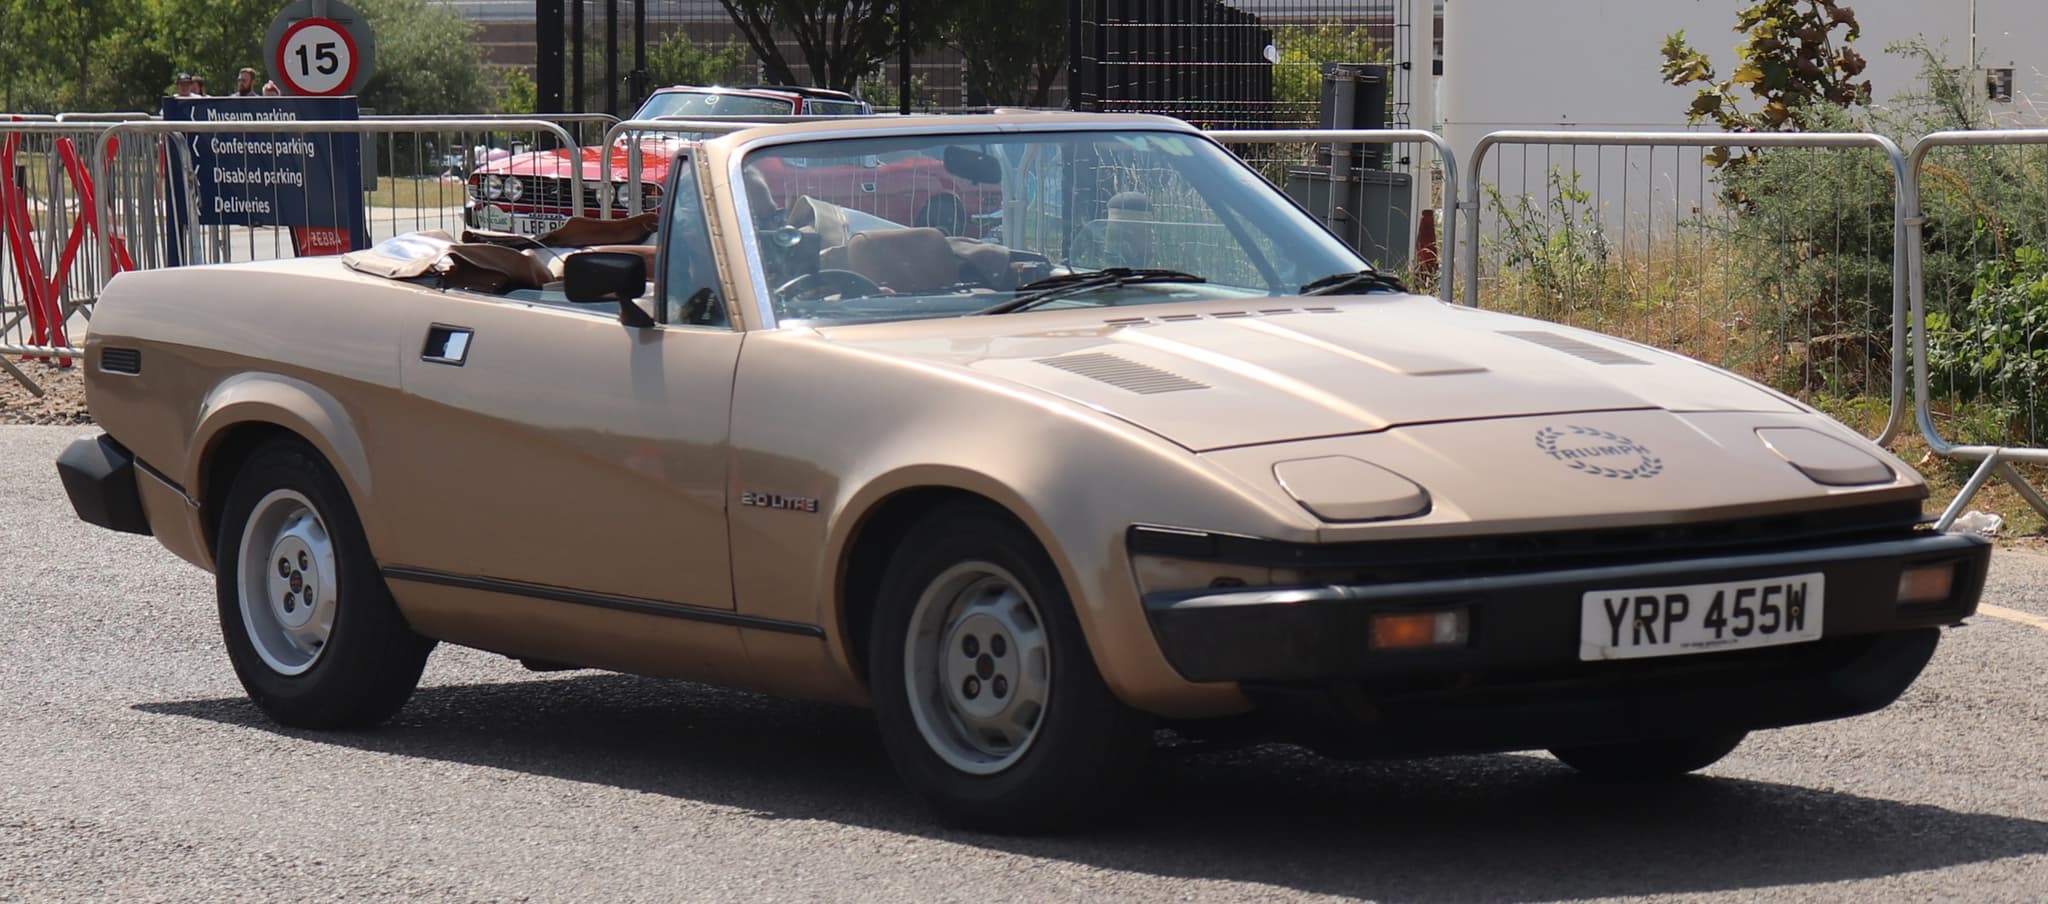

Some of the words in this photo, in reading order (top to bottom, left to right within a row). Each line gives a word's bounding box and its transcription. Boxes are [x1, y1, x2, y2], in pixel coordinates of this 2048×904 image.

[295, 42, 339, 76] 15
[207, 108, 253, 121] Museum
[211, 137, 272, 154] Conference
[275, 138, 315, 158] parking
[213, 167, 261, 183] Disabled
[264, 168, 303, 187] parking
[214, 196, 271, 213] Deliveries
[1546, 445, 1651, 461] TRIUMPH
[772, 495, 818, 513] LITRE
[1604, 593, 1690, 647] YRP
[1703, 582, 1808, 639] 455W
